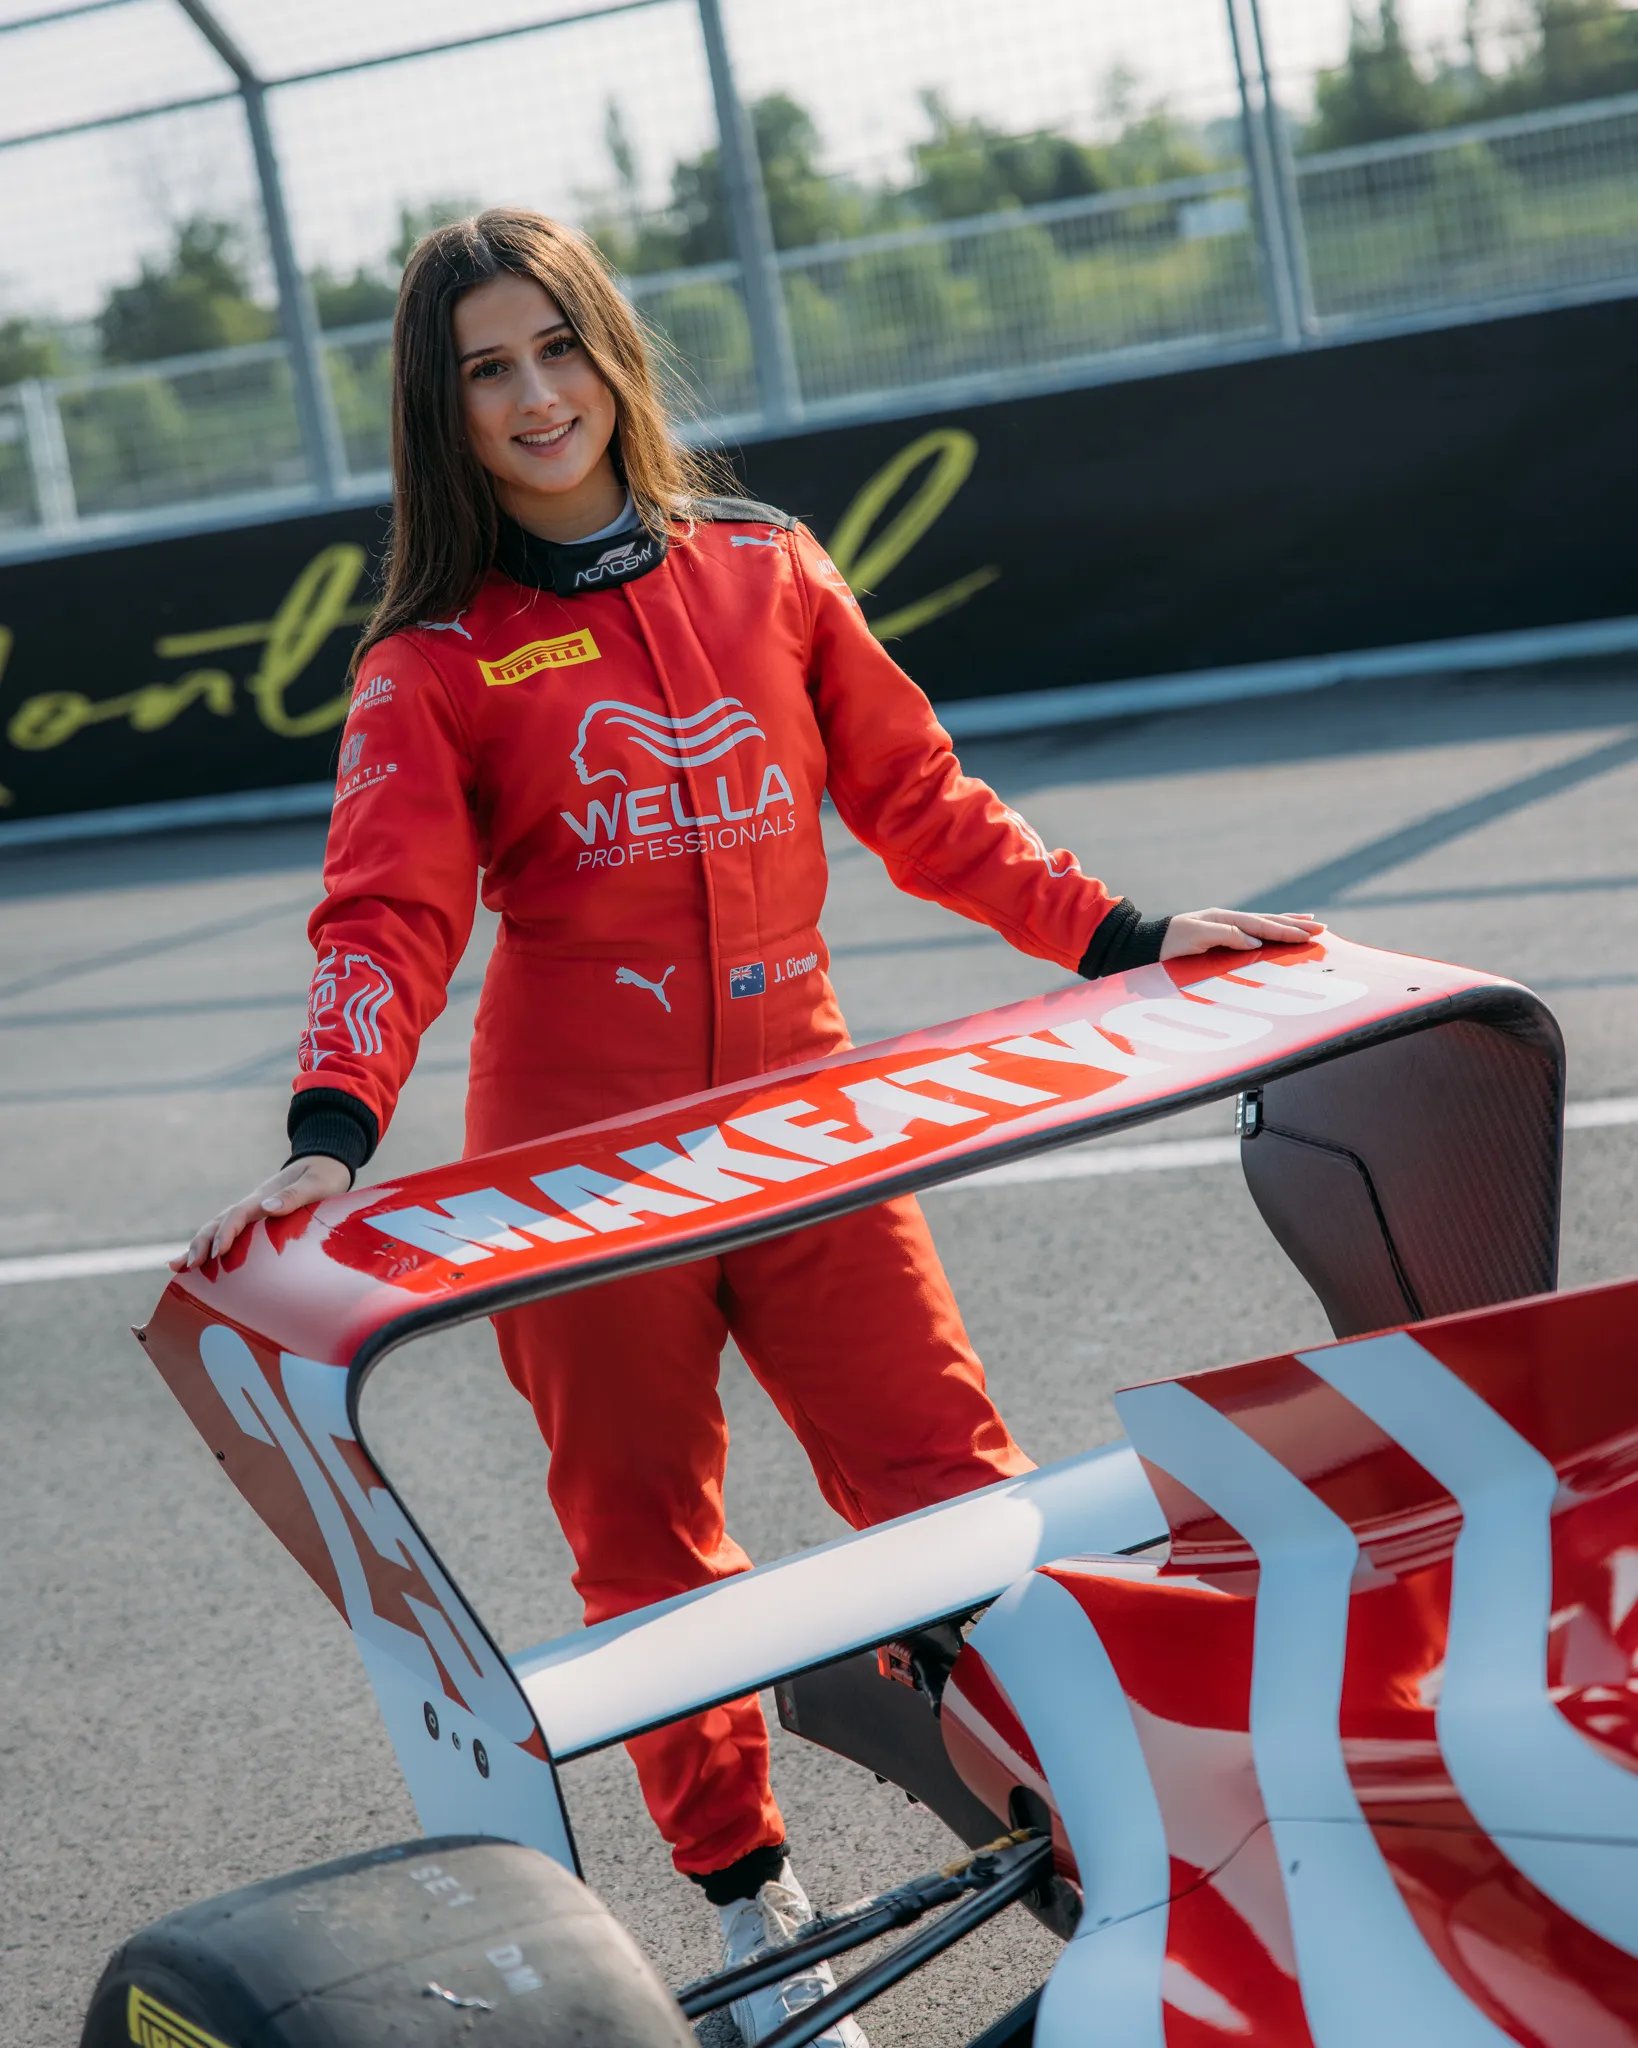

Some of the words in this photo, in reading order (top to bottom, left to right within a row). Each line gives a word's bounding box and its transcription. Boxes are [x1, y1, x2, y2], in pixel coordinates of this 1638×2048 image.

[575, 541, 653, 588] ACADEMY
[489, 638, 588, 681] PIRELLI
[349, 675, 392, 713] oodle
[364, 694, 393, 710] KITCHEN
[334, 763, 398, 801] LANTIS
[559, 763, 795, 846] WELLA
[575, 810, 797, 872] PROFESSIONALS
[774, 963, 786, 984] J.
[362, 1099, 914, 1266] MAKE
[986, 958, 1370, 1079] YOU
